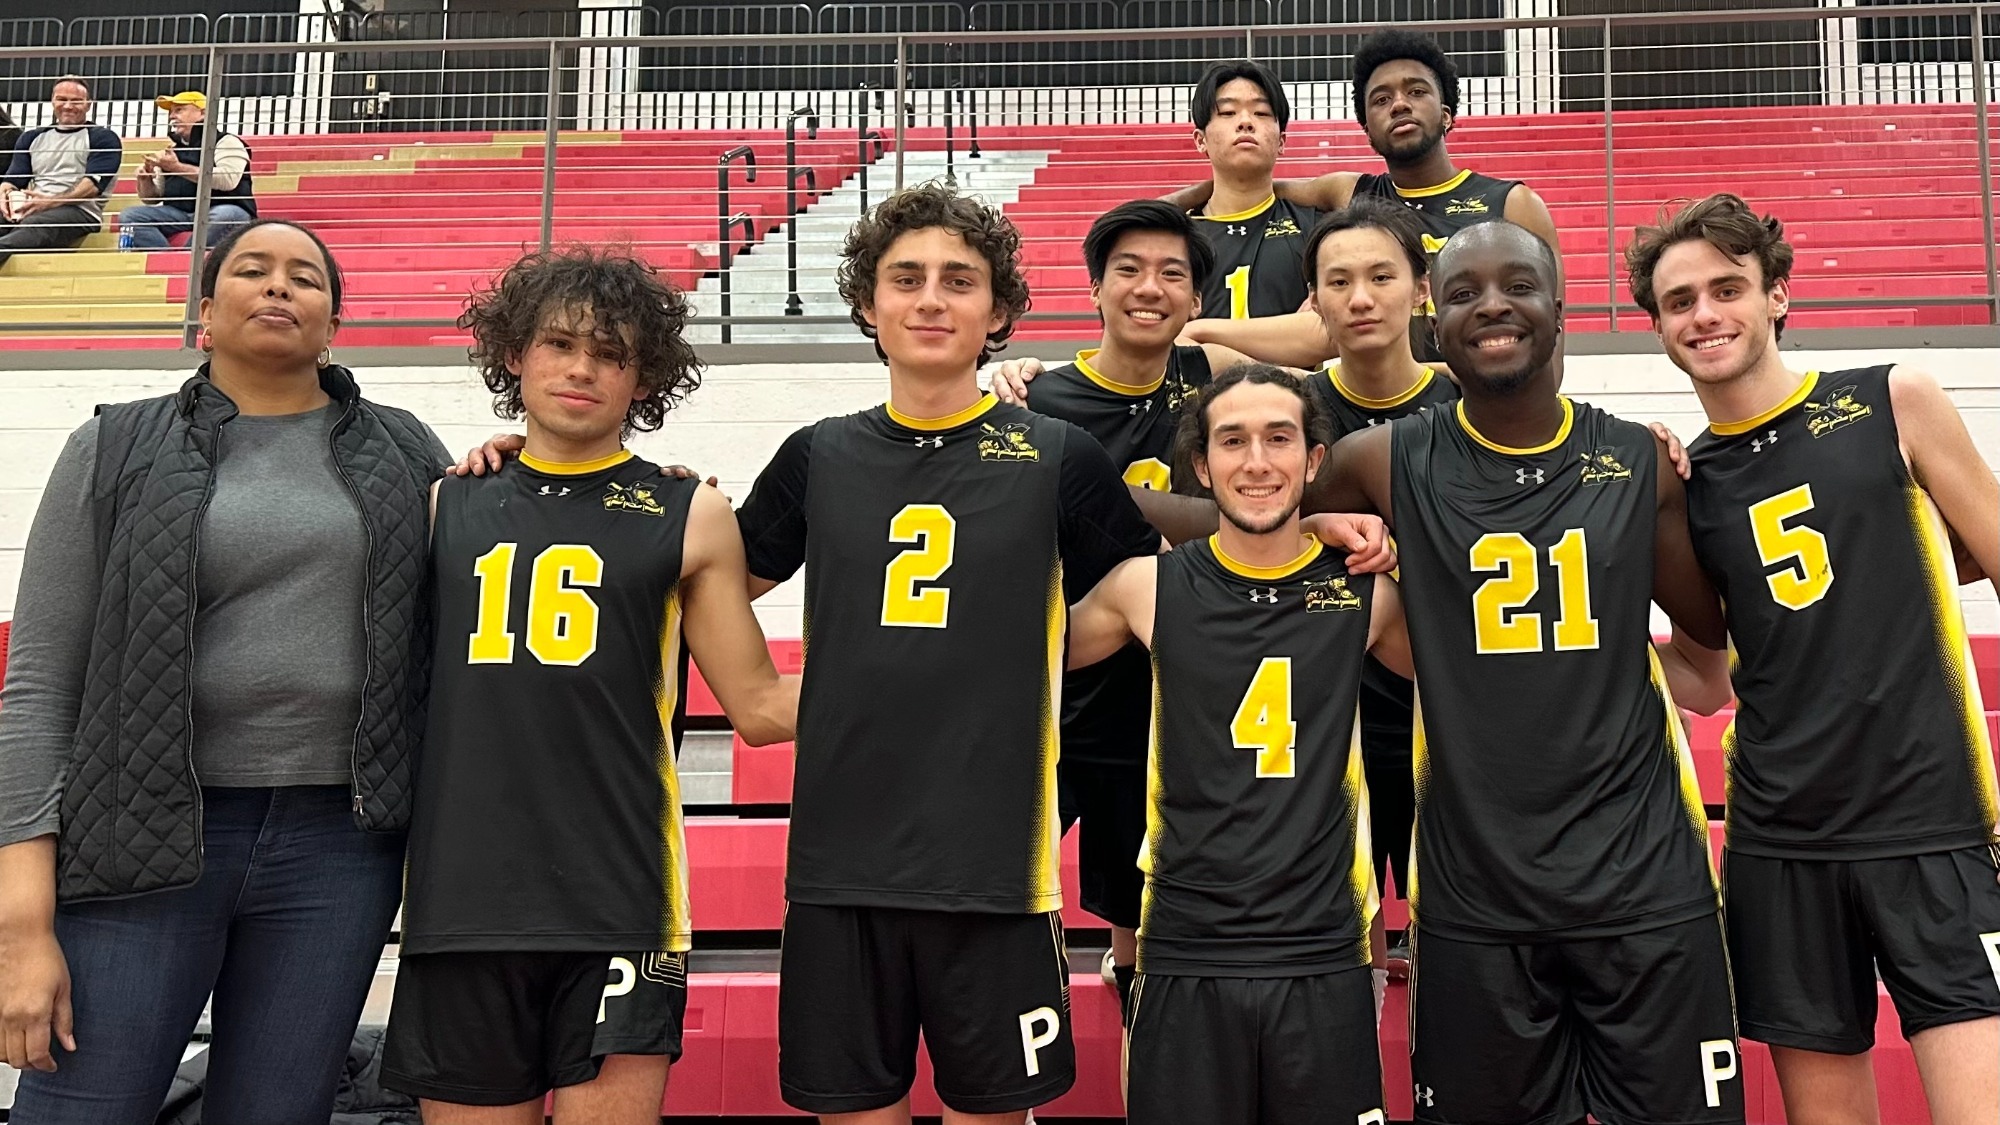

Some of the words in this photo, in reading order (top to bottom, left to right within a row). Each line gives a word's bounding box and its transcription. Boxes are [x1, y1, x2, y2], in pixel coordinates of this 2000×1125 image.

[1225, 265, 1250, 319] 1
[468, 543, 604, 666] 16
[881, 504, 956, 628] 2
[1470, 528, 1599, 654] 21
[1749, 483, 1834, 610] 5
[1230, 657, 1296, 778] 4
[596, 957, 635, 1024] P
[1019, 1007, 1059, 1076] P
[1701, 1040, 1736, 1107] P
